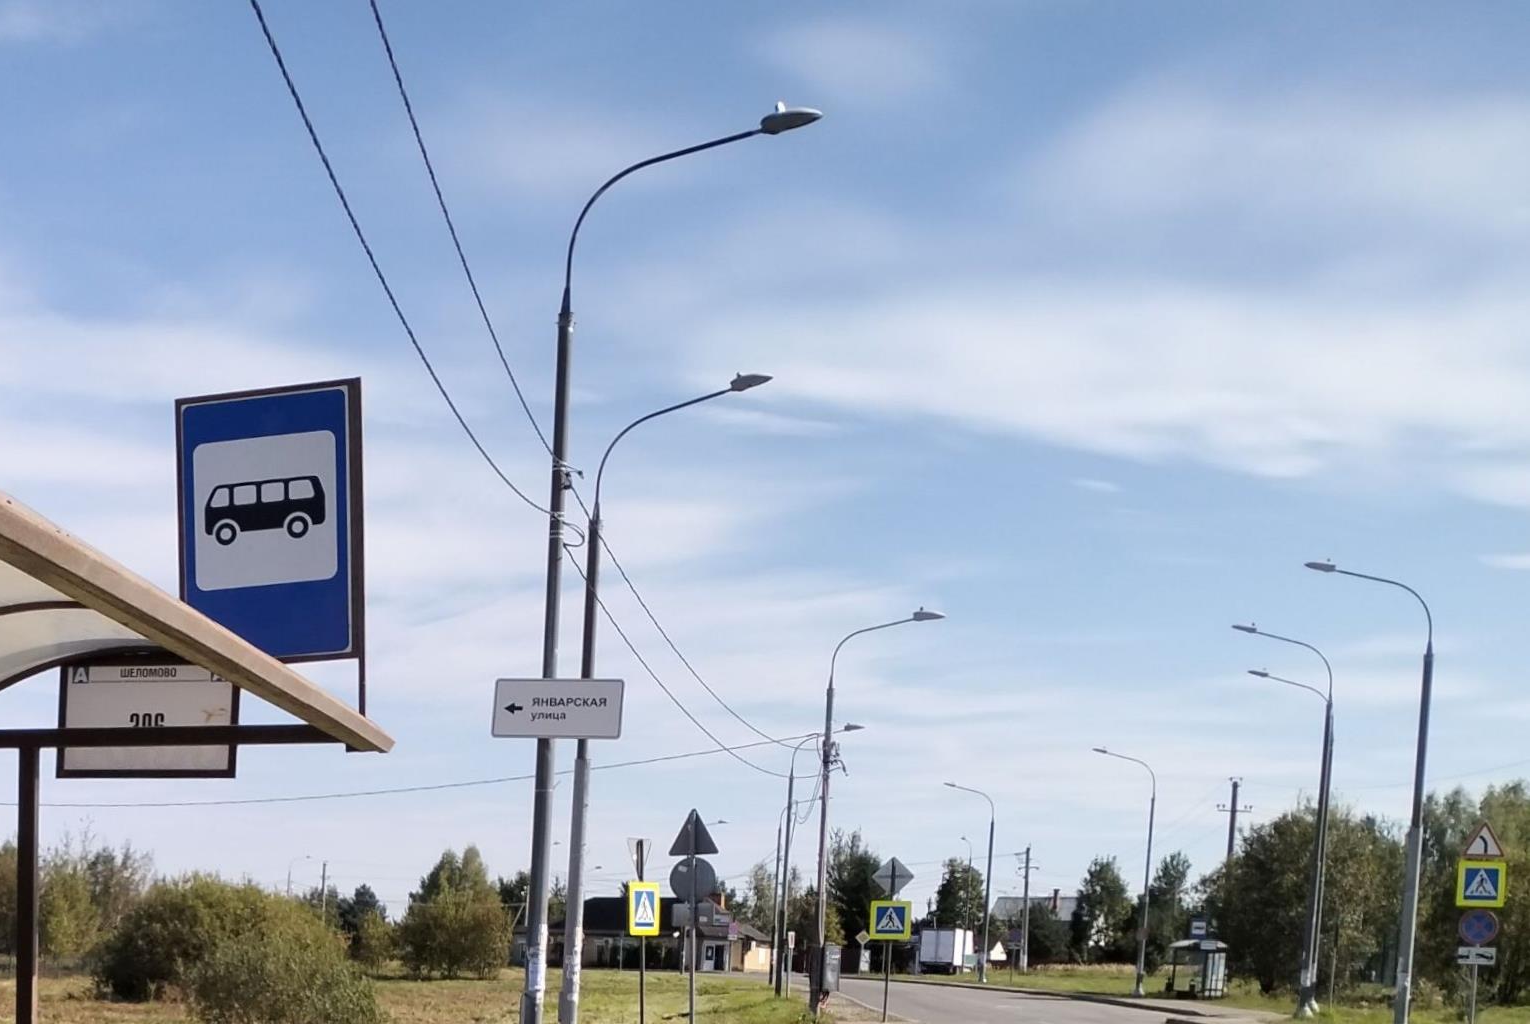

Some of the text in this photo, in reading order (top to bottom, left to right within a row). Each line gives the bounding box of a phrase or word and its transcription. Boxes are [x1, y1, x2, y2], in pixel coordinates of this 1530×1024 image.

[120, 667, 177, 679] ШЕЛОМОВО
[531, 697, 607, 707] ЯНВАРСКАЯ
[530, 711, 567, 721] улица
